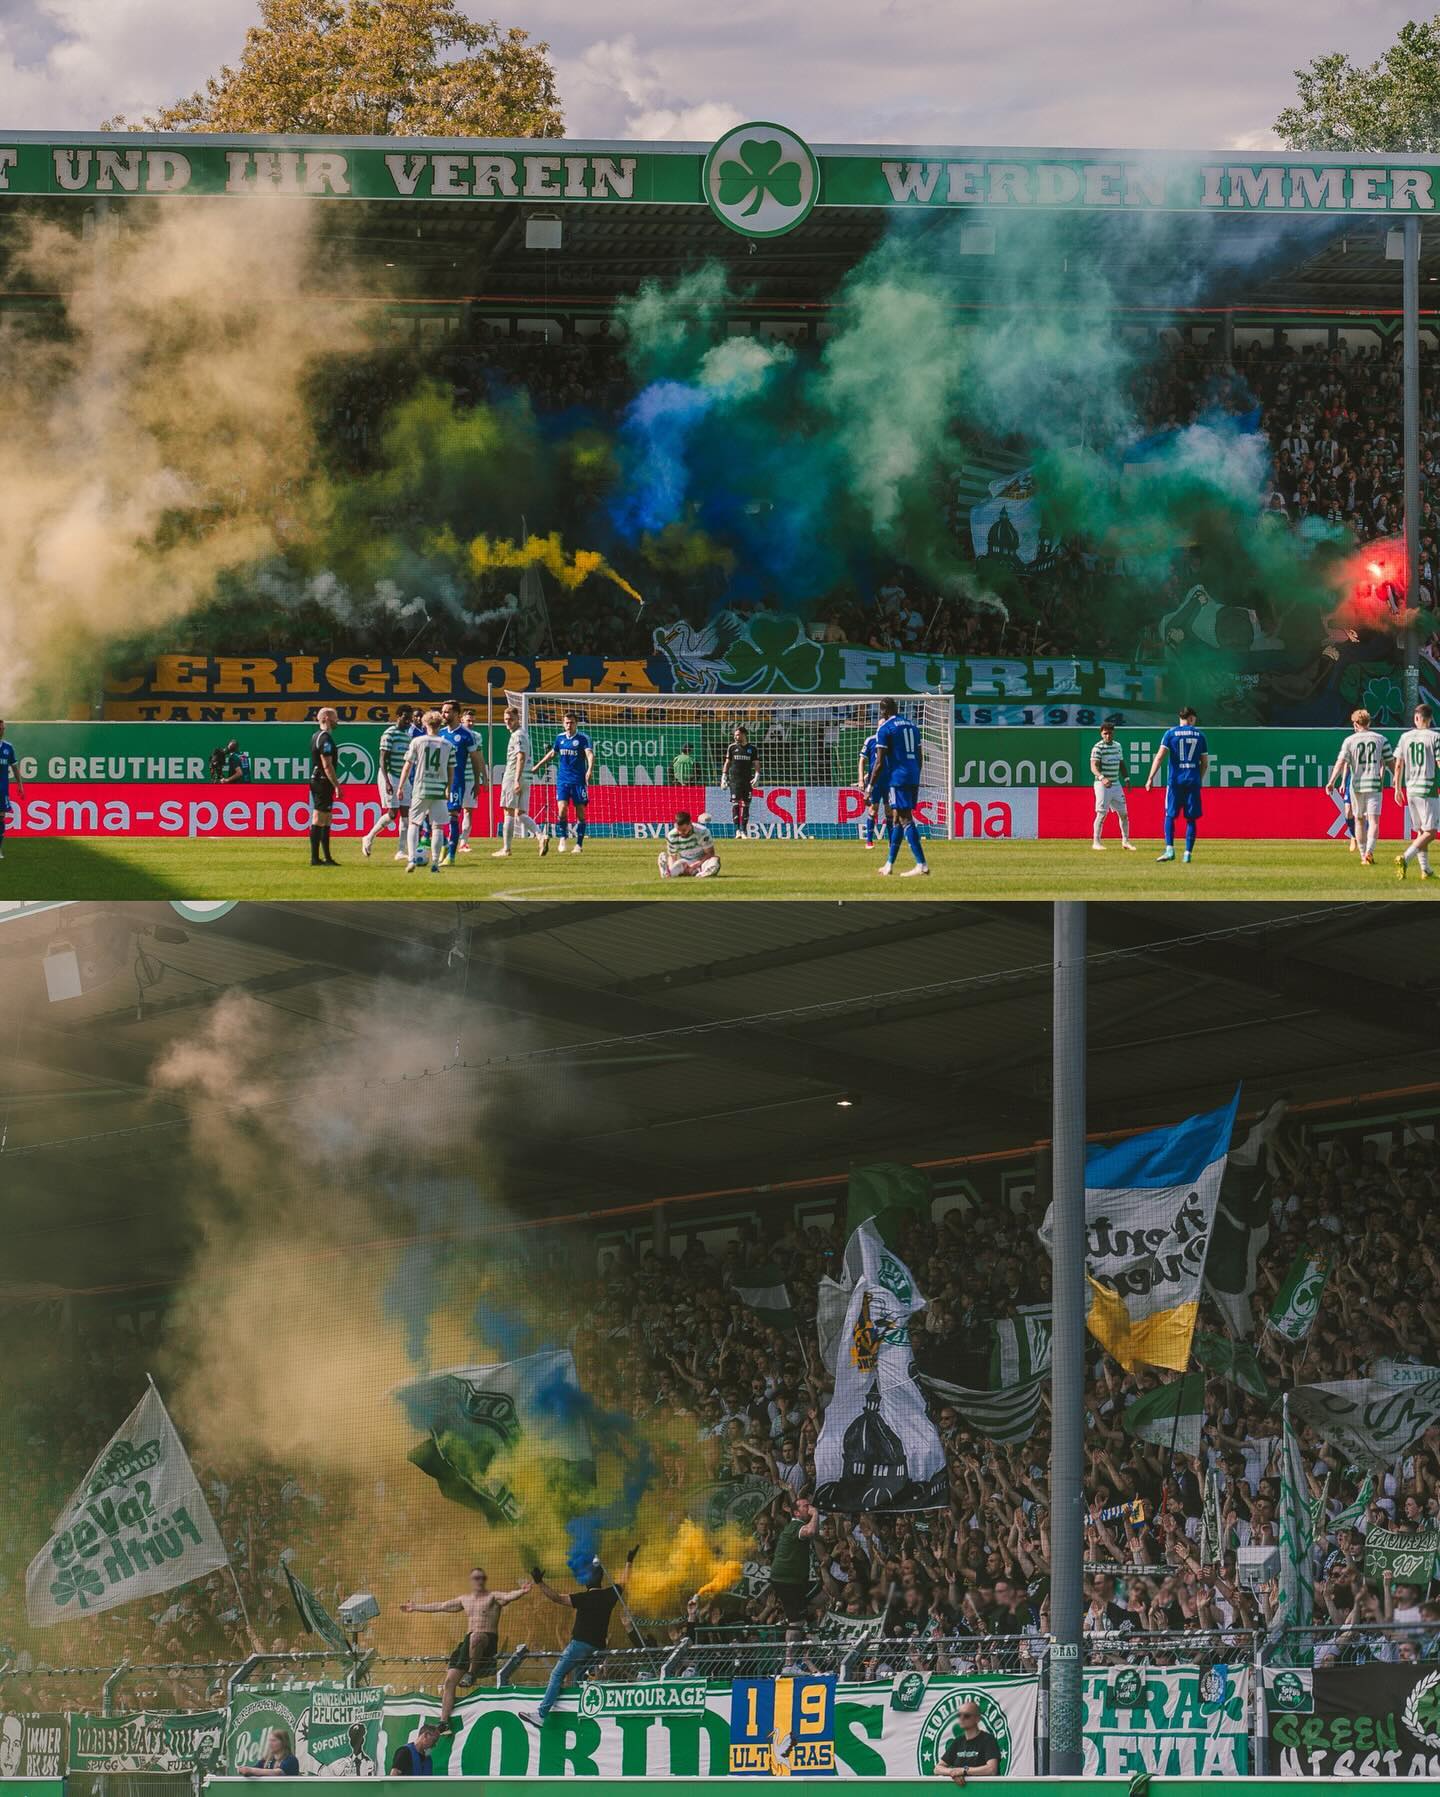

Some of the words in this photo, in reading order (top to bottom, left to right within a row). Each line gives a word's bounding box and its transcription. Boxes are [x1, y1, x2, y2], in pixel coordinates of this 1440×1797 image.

[52, 149, 192, 192] UND
[225, 151, 350, 194] IHR
[384, 153, 638, 198] VEREIN
[882, 161, 1162, 206] WERDEN
[1202, 166, 1436, 210] IMMER
[139, 706, 278, 722] TANTI
[1022, 708, 1127, 726] 1984
[903, 727, 915, 753] 11
[1179, 737, 1198, 761] 17
[424, 746, 441, 772] 14
[1357, 741, 1377, 765] 22
[1409, 741, 1425, 768] 18
[48, 757, 205, 779] GREUTHER
[958, 759, 1074, 787] signia
[605, 1687, 706, 1707] ENTOURAGE
[313, 1707, 353, 1723] PFLICHT
[27, 1727, 61, 1754] IMMER
[312, 1732, 347, 1754] SOFORT!
[382, 1702, 887, 1777] HORIDS
[1272, 1712, 1400, 1752] GREEN
